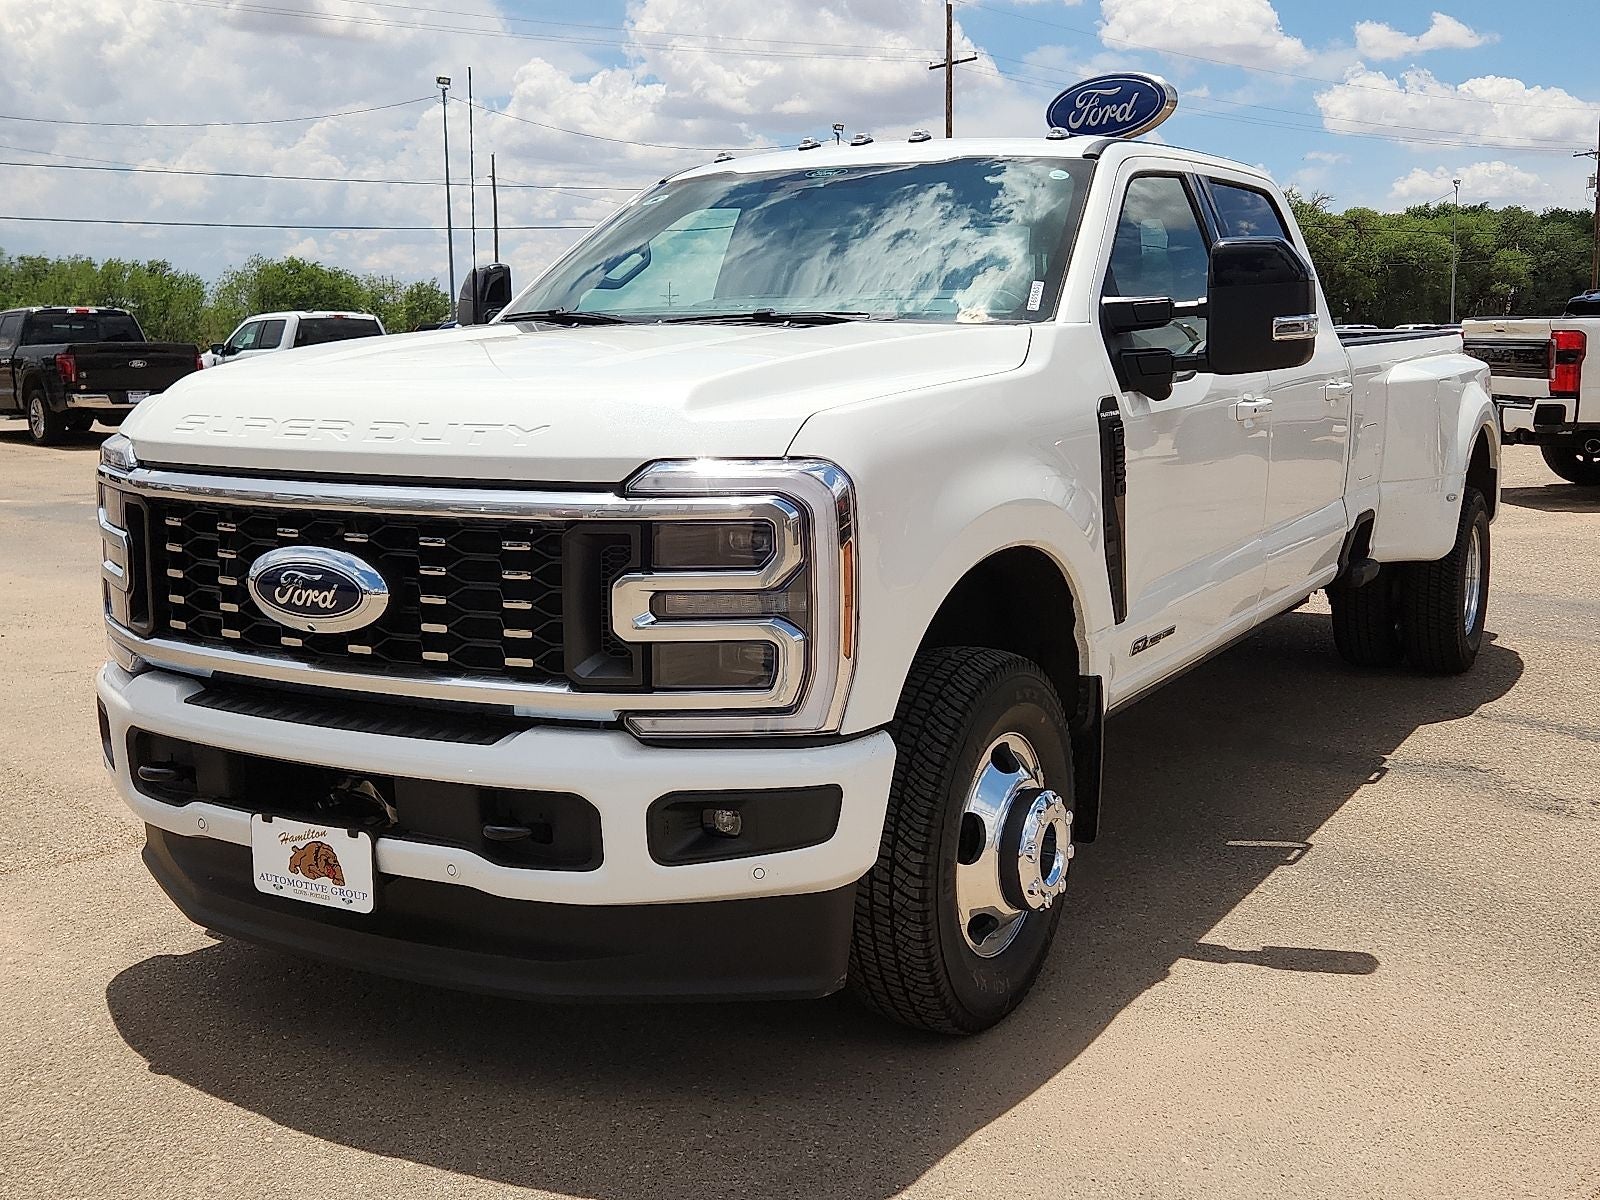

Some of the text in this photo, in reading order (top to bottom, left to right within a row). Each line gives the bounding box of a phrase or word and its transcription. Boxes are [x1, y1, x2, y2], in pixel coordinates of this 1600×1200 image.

[1068, 86, 1139, 129] Ford
[173, 413, 551, 447] SUPER DUTY
[274, 570, 339, 609] Ford
[278, 829, 328, 845] Hamilton
[259, 872, 368, 901] AUTOMOTIVE GROUP
